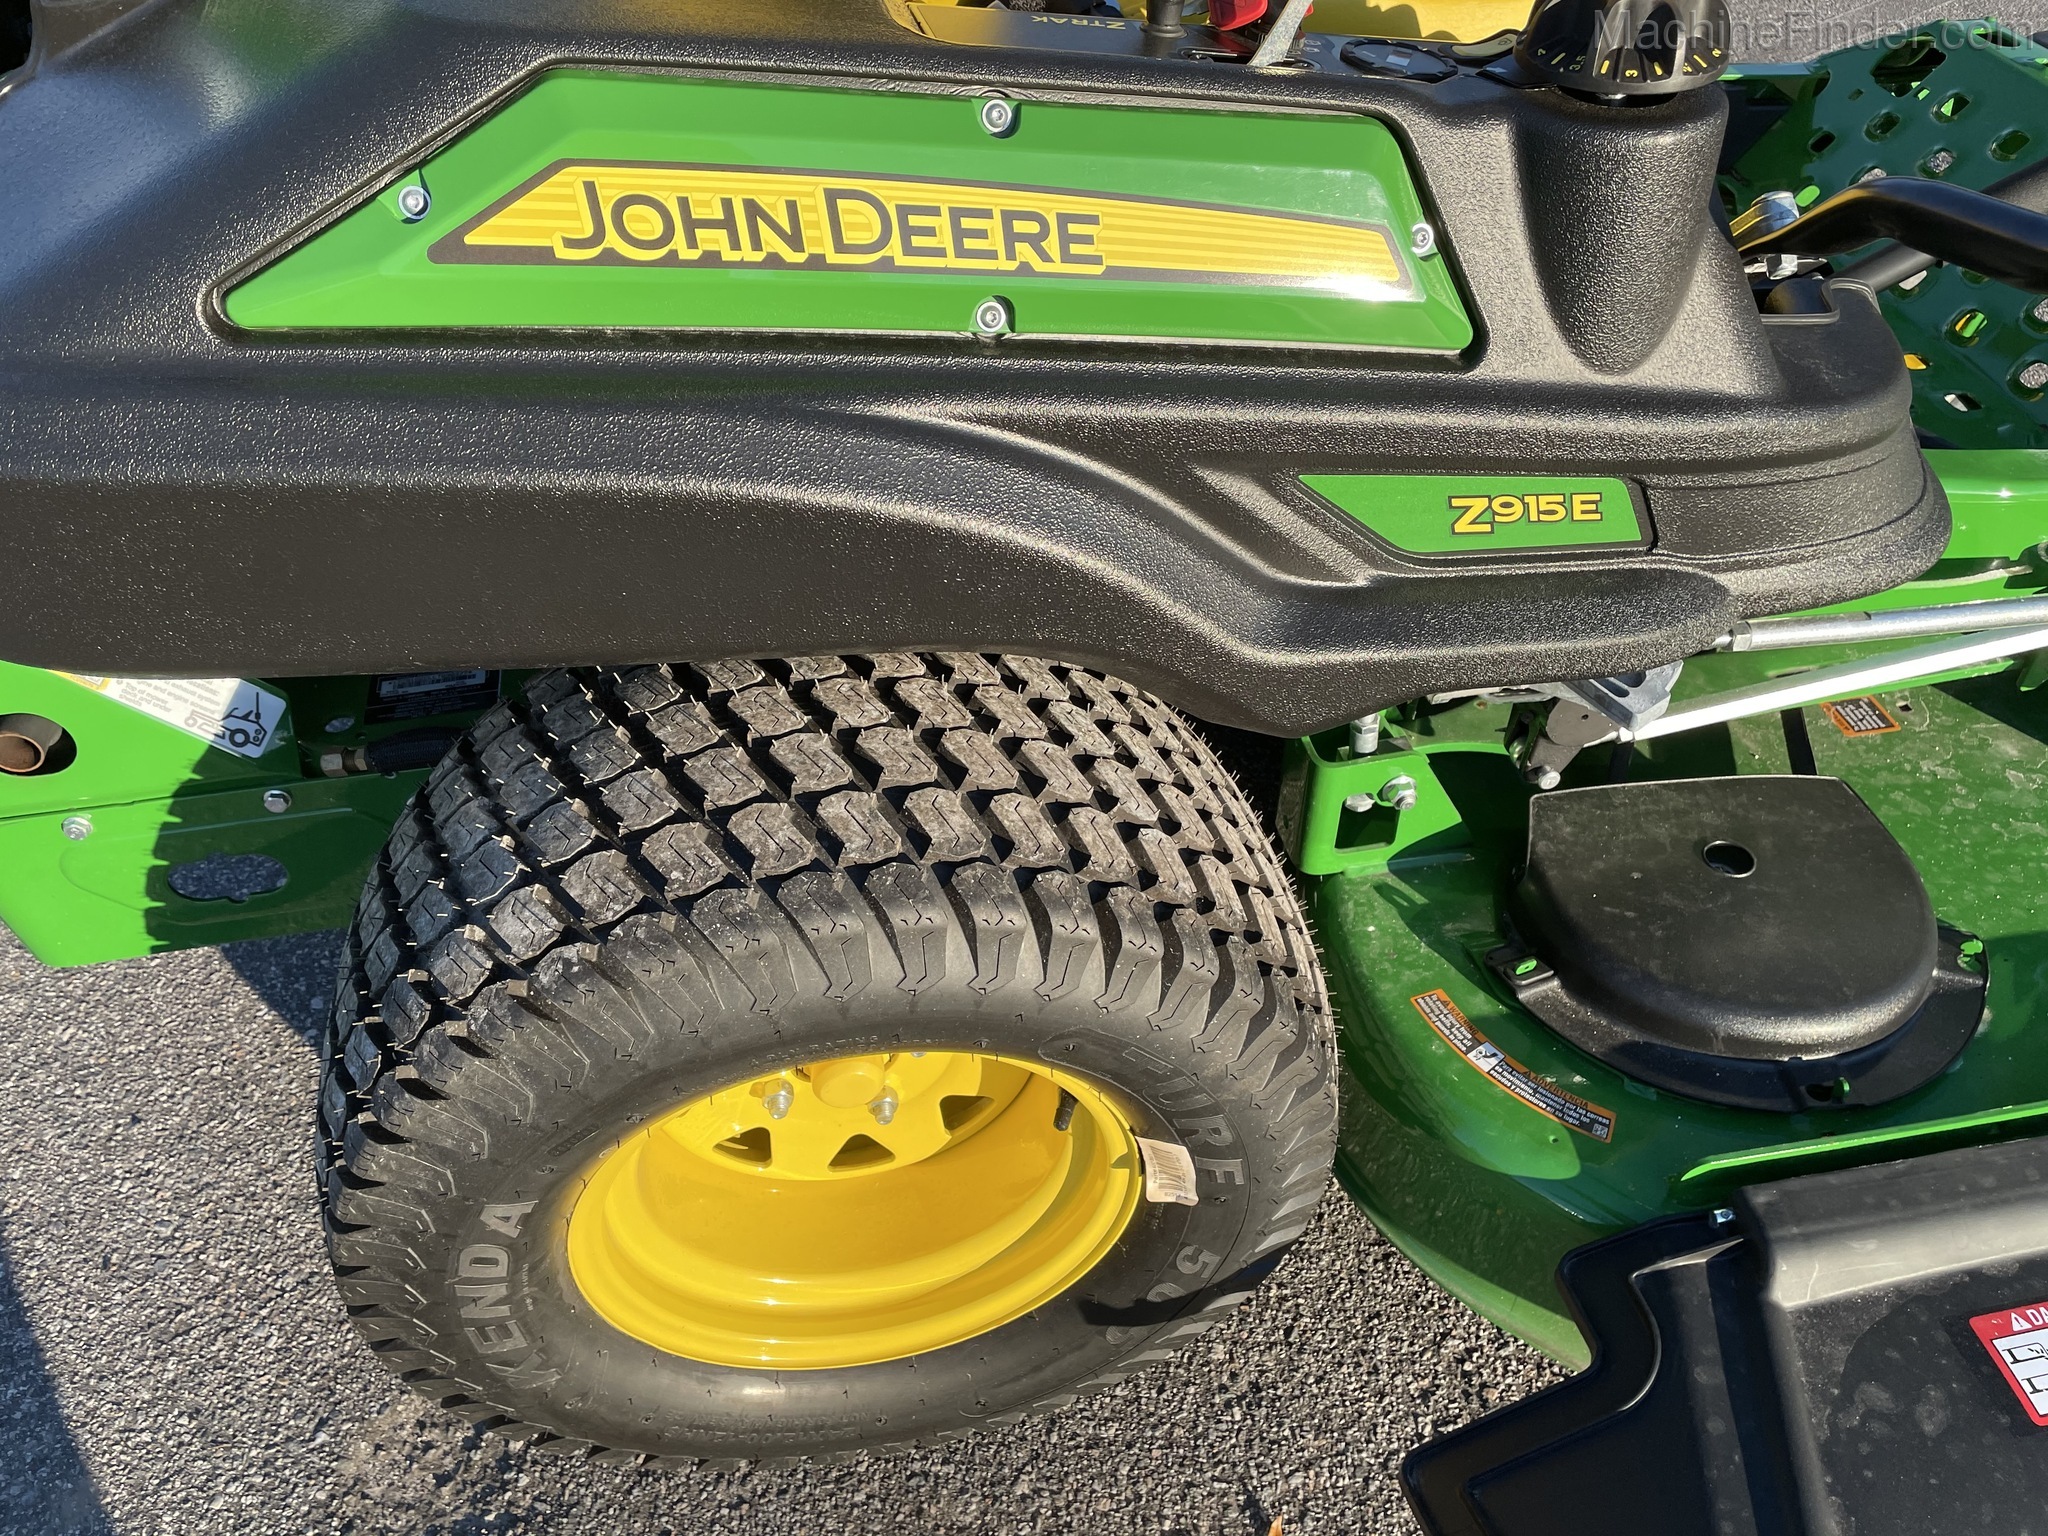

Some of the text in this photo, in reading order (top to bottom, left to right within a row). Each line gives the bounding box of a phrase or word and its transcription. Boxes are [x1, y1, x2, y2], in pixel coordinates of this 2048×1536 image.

[1031, 15, 1126, 30] ZTRAK
[1625, 69, 1638, 78] 3
[556, 180, 1107, 272] JOHN DEERE
[1448, 492, 1603, 536] Z915E
[1450, 1005, 1478, 1036] WARNING
[1514, 1086, 1547, 1109] protectores
[1532, 1074, 1589, 1109] ADVERTENCIA
[1535, 1091, 1563, 1111] mantener
[1537, 1085, 1565, 1105] lesionado
[1587, 1110, 1609, 1125] correas
[453, 1200, 563, 1390] KENDA
